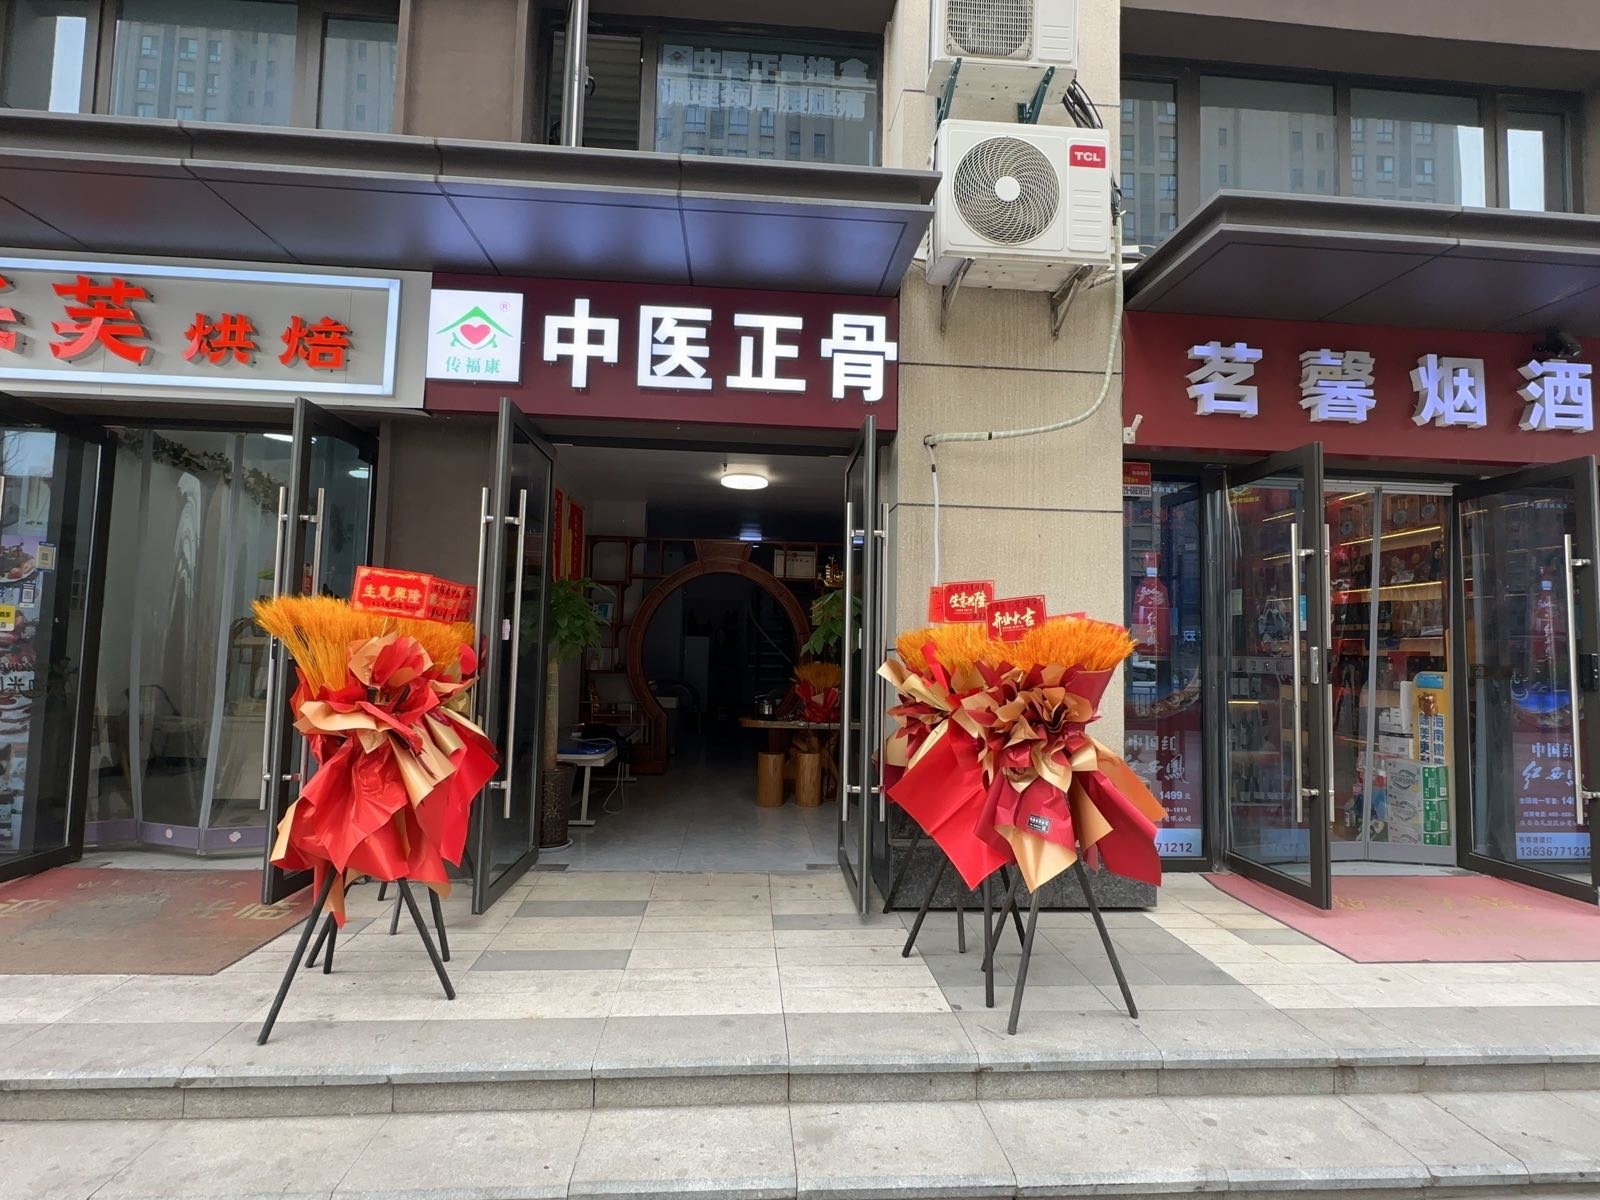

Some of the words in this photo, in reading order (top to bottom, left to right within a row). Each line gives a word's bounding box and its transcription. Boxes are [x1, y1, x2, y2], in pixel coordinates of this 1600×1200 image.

[1074, 151, 1101, 162] TCL
[183, 312, 351, 371] 烘焙
[543, 298, 897, 402] 中医正骨
[445, 355, 501, 375] 传福康
[1185, 341, 1594, 434] 茗馨烟酒
[992, 607, 1036, 636] 开业大吉
[1159, 791, 1183, 800] 1499
